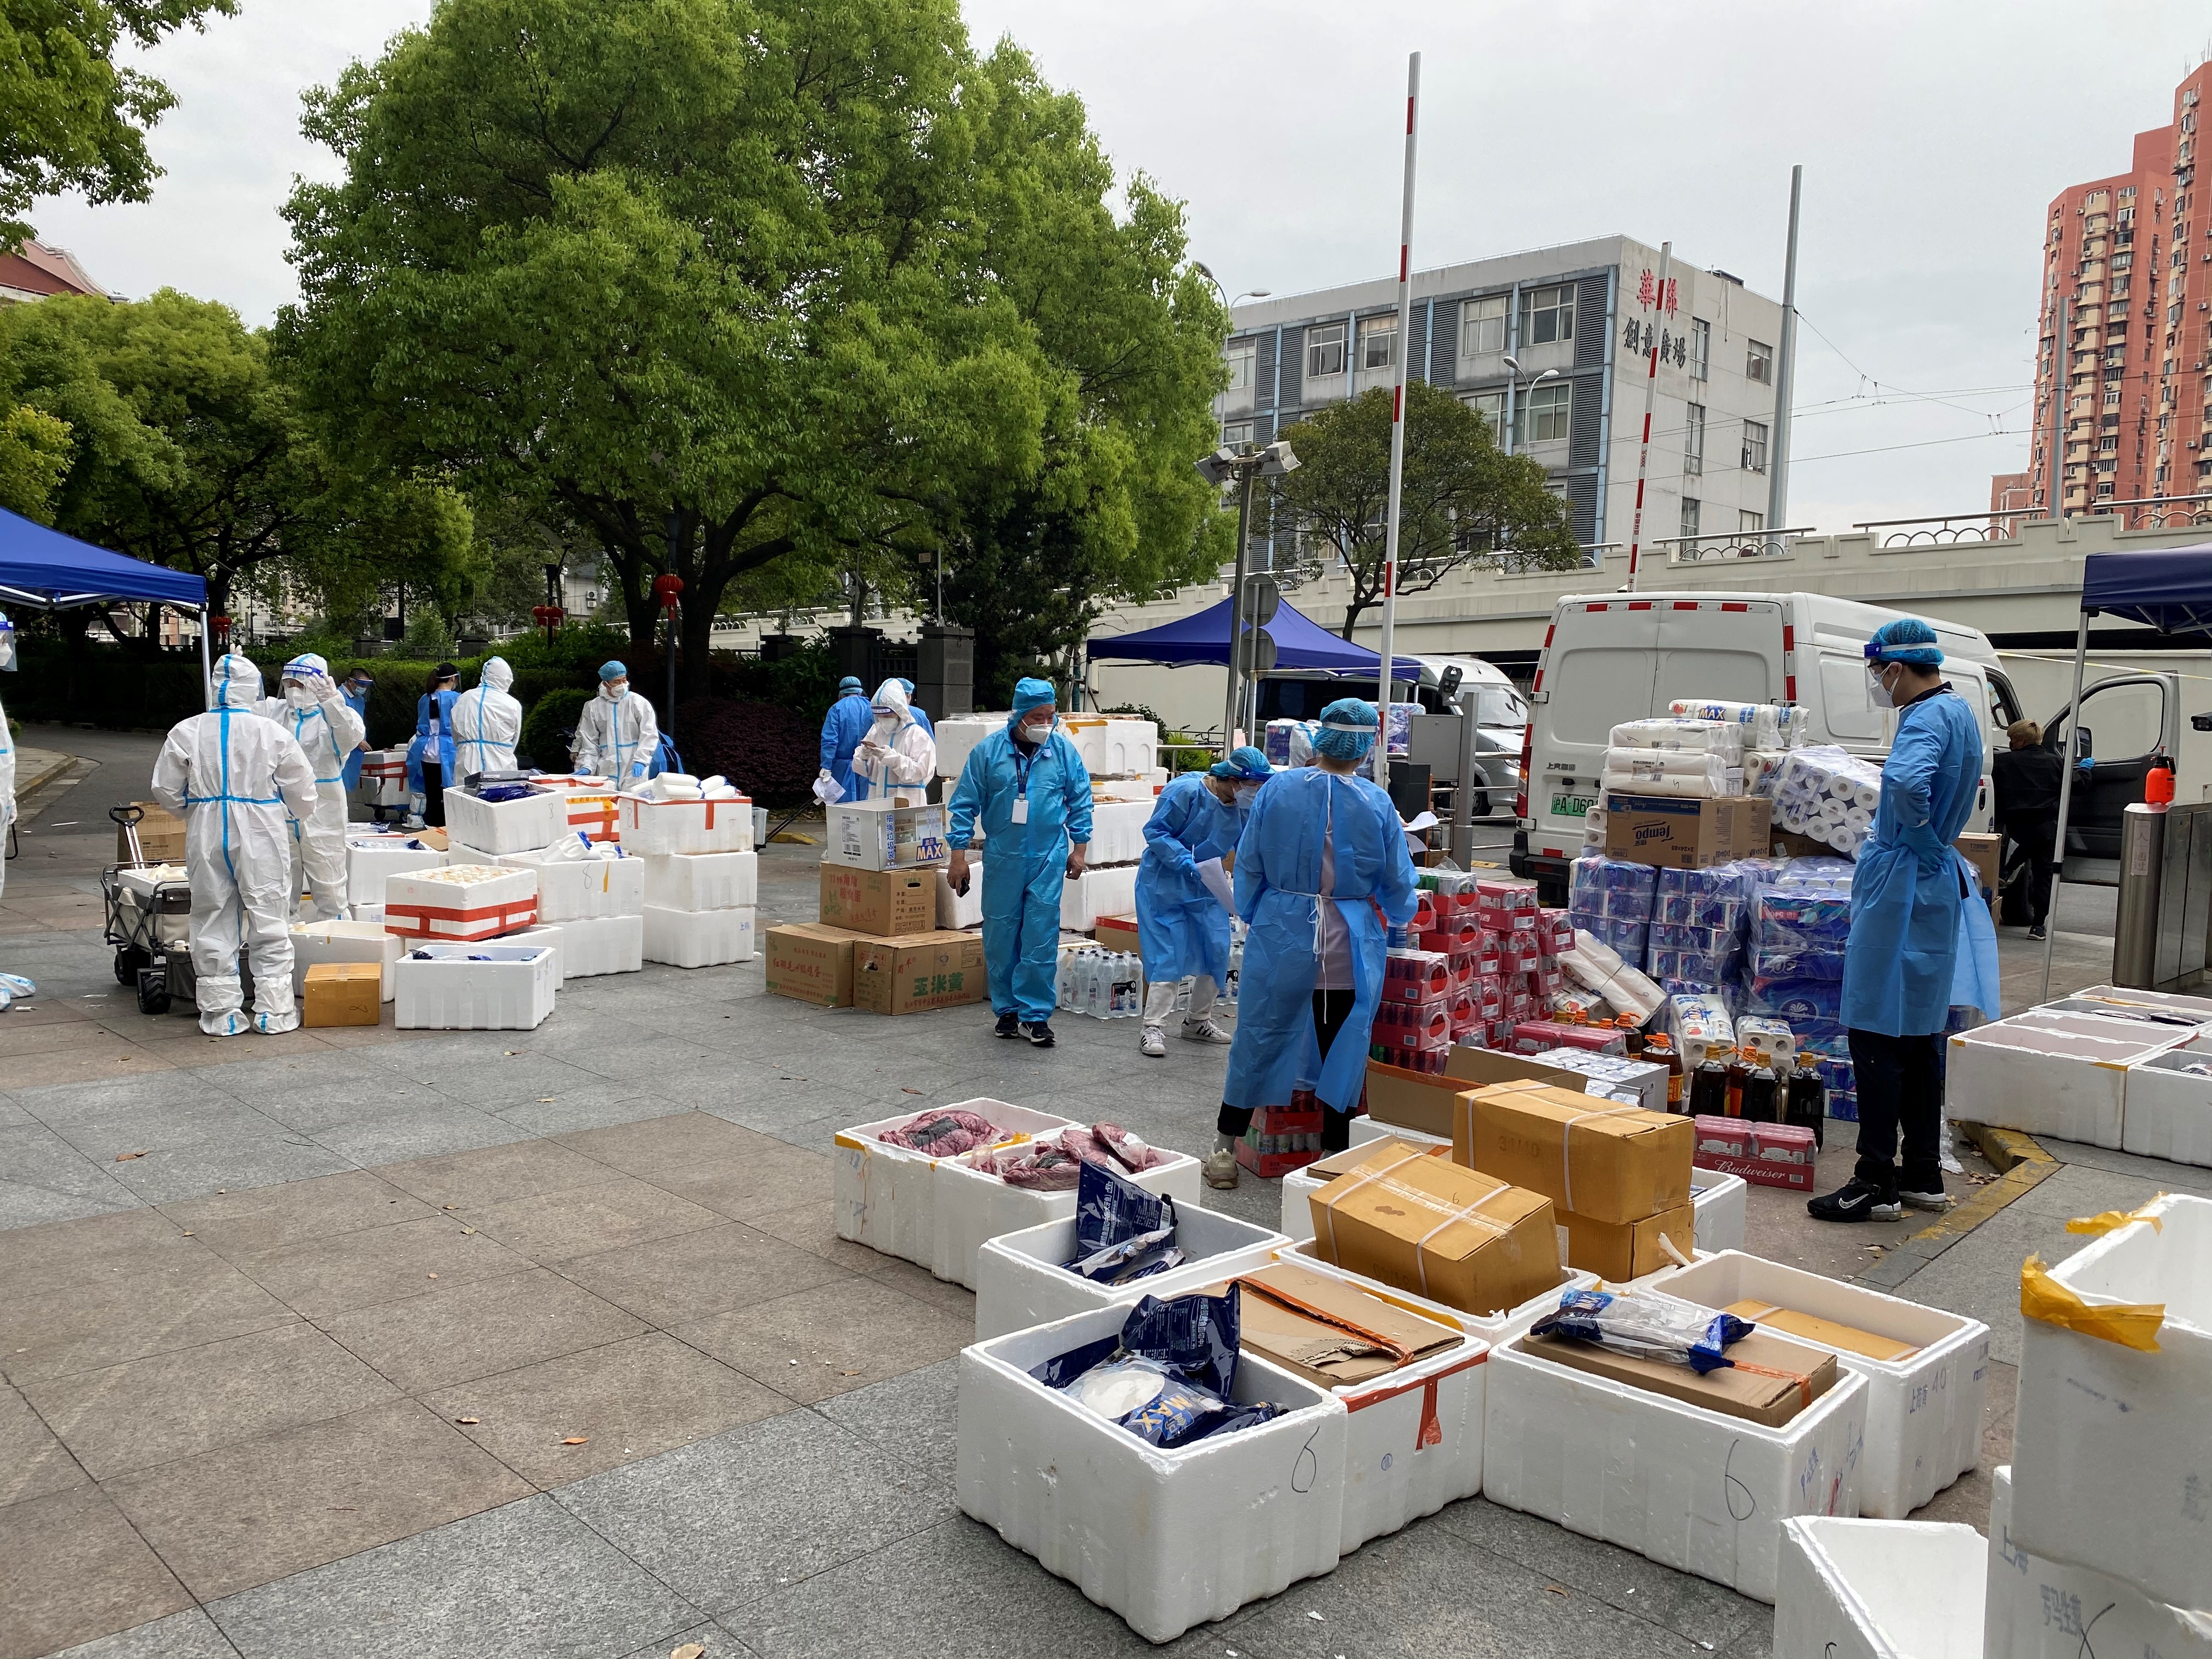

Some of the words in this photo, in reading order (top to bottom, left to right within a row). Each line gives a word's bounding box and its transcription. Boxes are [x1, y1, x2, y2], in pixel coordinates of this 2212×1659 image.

[1699, 707, 1726, 720] MAX
[1634, 825, 1675, 843] Tempo
[917, 843, 943, 861] MAX
[912, 972, 964, 997] 玉米黄
[1714, 1159, 1786, 1180] Budweiser
[1452, 1192, 1460, 1204] 6
[1131, 1395, 1193, 1434] MAX
[1290, 1425, 1320, 1493] 6
[1724, 1438, 1757, 1521] 6
